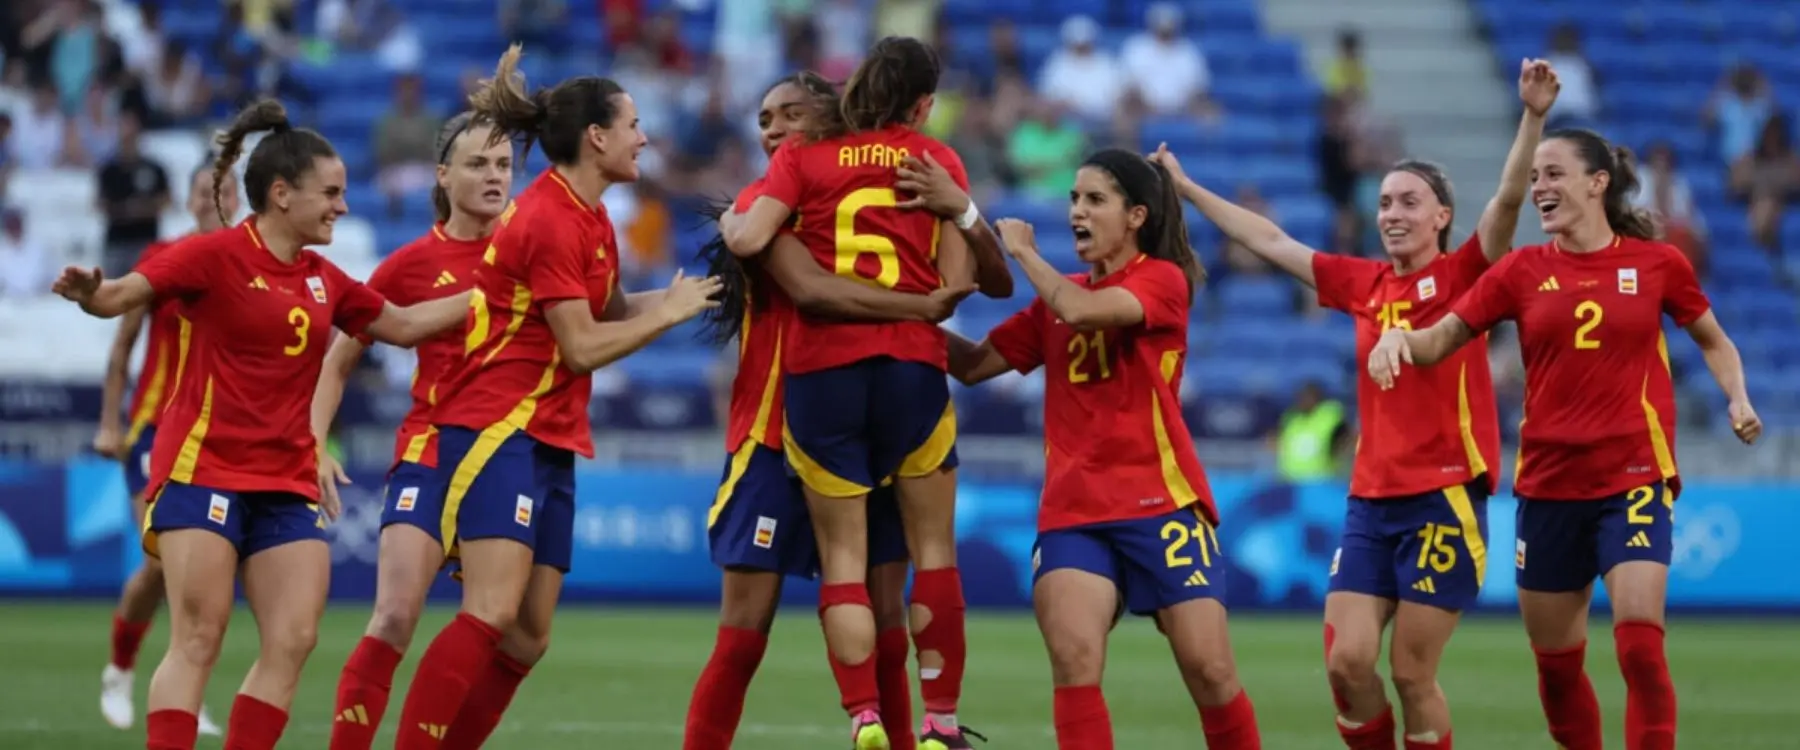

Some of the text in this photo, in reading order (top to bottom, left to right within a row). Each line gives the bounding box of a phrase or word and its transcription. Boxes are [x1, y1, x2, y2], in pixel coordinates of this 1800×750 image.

[838, 144, 909, 168] AITANA
[836, 188, 900, 288] 6
[284, 307, 310, 356] 3
[1377, 302, 1413, 334] 15
[1575, 301, 1602, 348] 2
[1067, 331, 1110, 383] 21
[1627, 486, 1654, 524] 2
[1161, 521, 1211, 568] 21
[1417, 523, 1460, 573] 15
